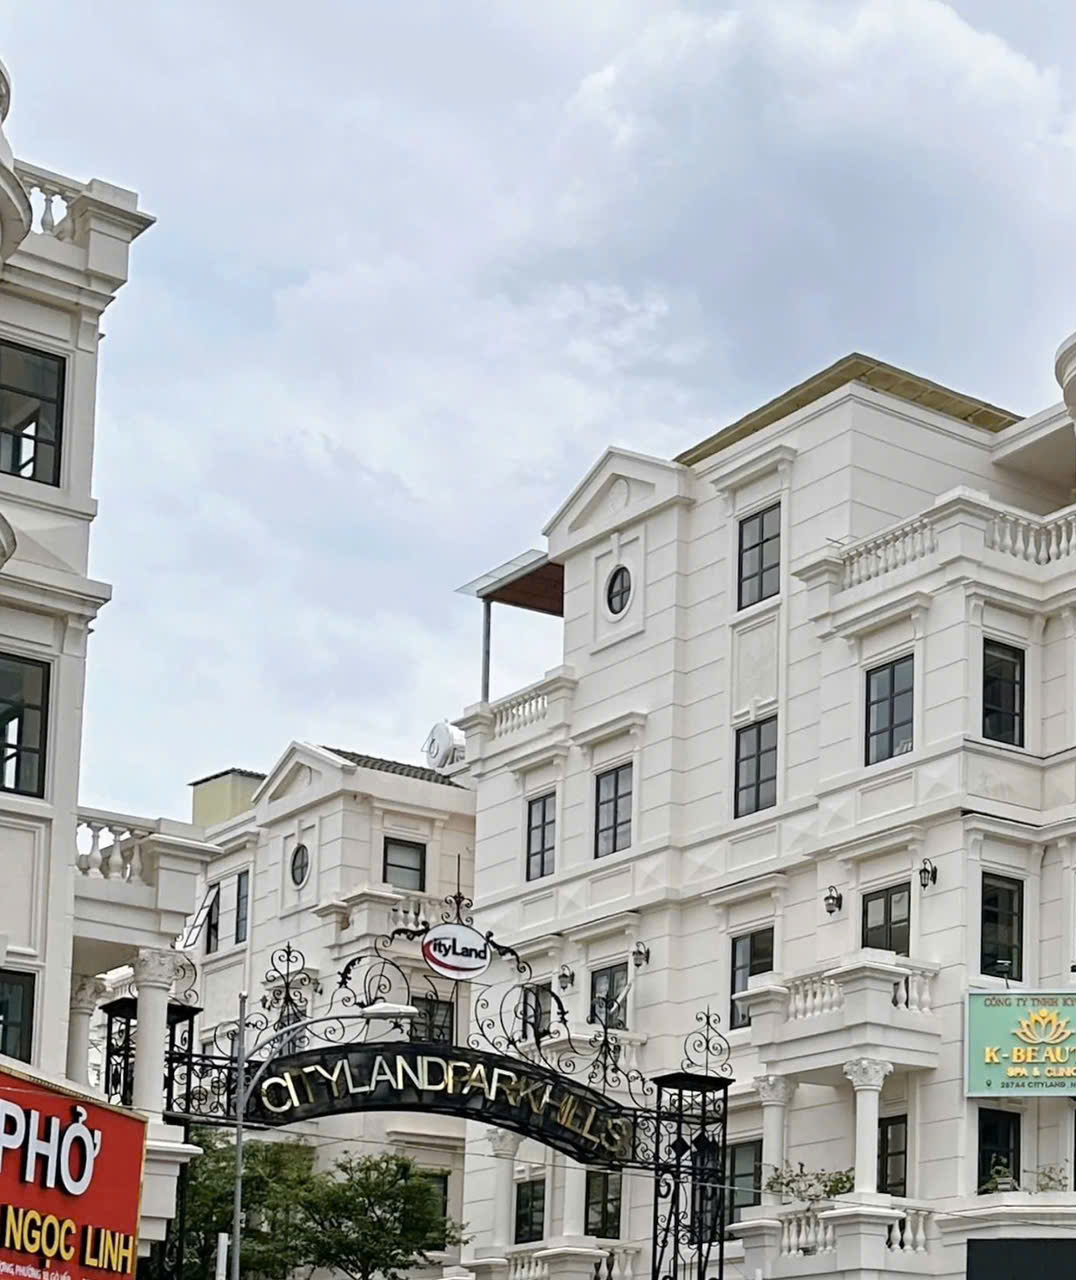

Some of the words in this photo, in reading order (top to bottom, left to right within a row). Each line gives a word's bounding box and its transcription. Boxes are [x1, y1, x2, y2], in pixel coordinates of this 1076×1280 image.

[1016, 998, 1027, 1007] TY
[1007, 1066, 1028, 1078] SPA
[0, 1098, 102, 1196] PHỞ
[5, 1205, 77, 1268] NGỌC
[84, 1224, 134, 1274] LINH
